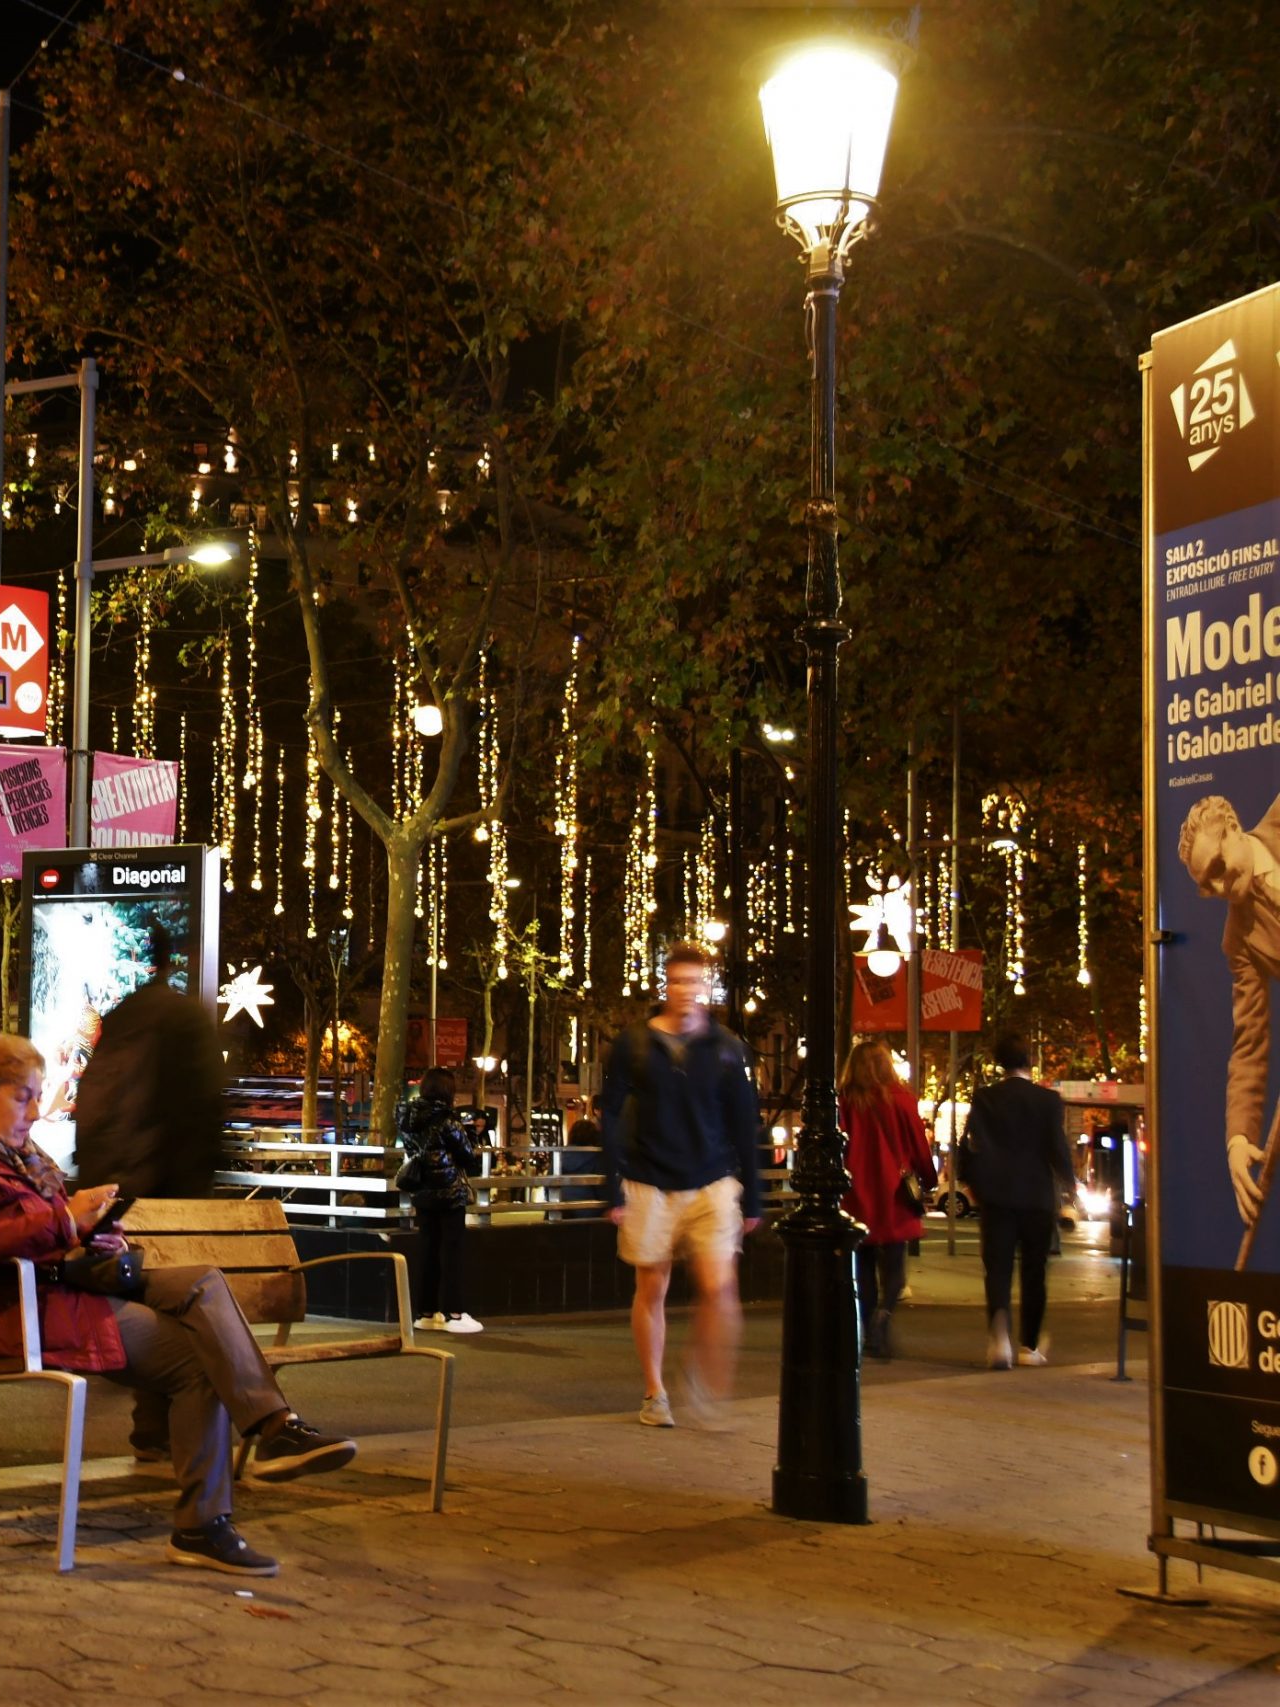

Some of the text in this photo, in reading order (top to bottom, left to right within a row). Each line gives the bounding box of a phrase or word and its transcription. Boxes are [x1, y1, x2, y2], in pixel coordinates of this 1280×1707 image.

[1189, 367, 1235, 425] 25
[1189, 414, 1235, 446] anys
[1166, 539, 1204, 566] SALA 2
[1166, 538, 1280, 586] EXPOSICIÓ FINS AL
[1166, 560, 1275, 602] ENTRADA LLIURE FREE ENTRY
[1, 622, 27, 652] M
[1166, 592, 1280, 681] Mode
[1167, 693, 1191, 725] de
[1194, 672, 1272, 719] Gabriel
[1167, 712, 1280, 764] i Galobarde
[97, 851, 138, 860] Clear Channel
[113, 865, 186, 888] Diagonal
